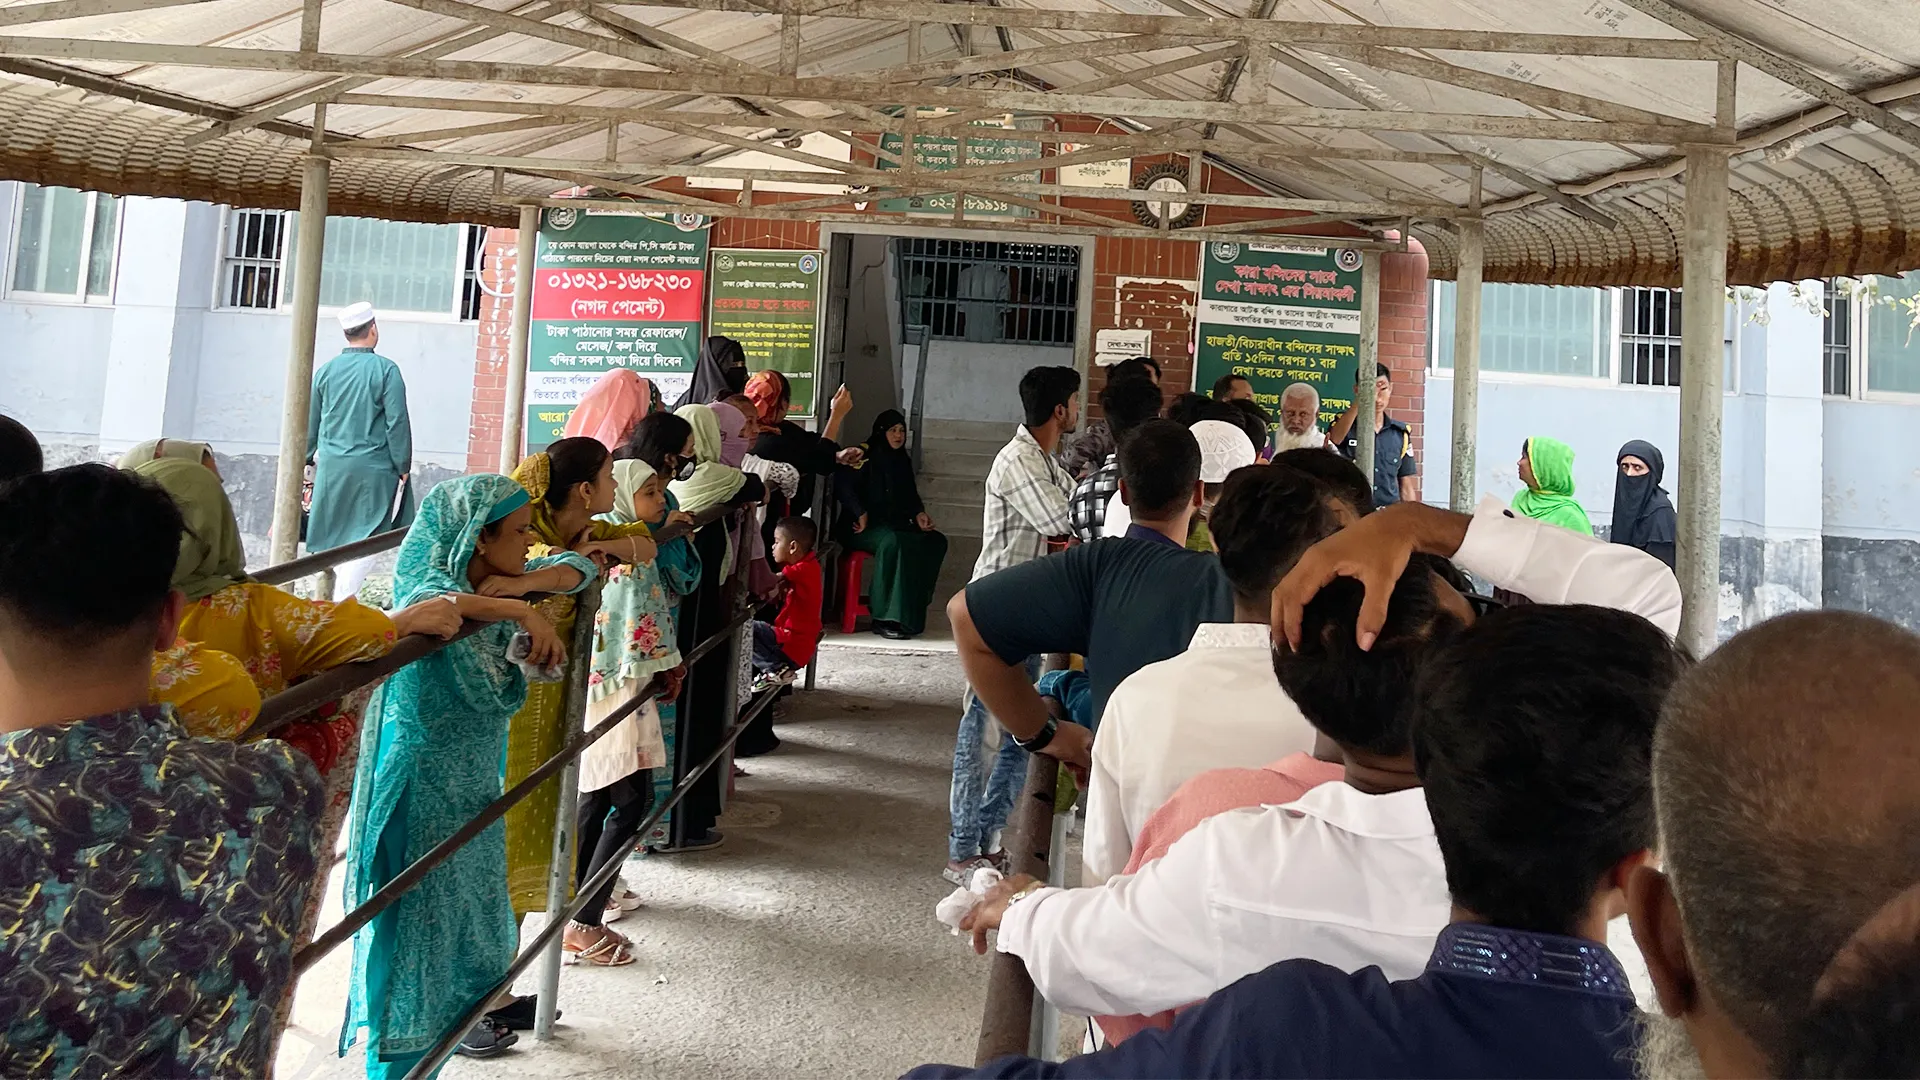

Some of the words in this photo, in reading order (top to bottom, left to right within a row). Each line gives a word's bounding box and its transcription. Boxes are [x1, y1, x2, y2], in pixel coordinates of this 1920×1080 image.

[559, 241, 576, 251] কোন
[679, 241, 695, 251] টাকা
[541, 253, 566, 263] পাঠাতে
[567, 255, 593, 263] পারবেন
[634, 256, 649, 264] নগদ
[1233, 264, 1261, 279] কারা
[1262, 264, 1308, 282] বন্দিদের
[548, 271, 692, 292] ০১৩২১-১৬৮২৩০
[1215, 279, 1243, 294] দেখা
[1243, 281, 1279, 297] সাক্ষাৎ
[1281, 285, 1301, 299] এর
[571, 298, 608, 318] (নগদ
[612, 297, 665, 319] পেমেন্ট)
[1209, 303, 1238, 313] কারাগারে
[1239, 305, 1258, 314] আটক
[1261, 306, 1274, 316] বন্দি
[1284, 309, 1305, 318] তাদের
[1233, 315, 1262, 325] অবগতির
[1263, 318, 1277, 327] জন্য
[1279, 319, 1304, 328] জানানো
[546, 324, 569, 337] টাকা
[572, 325, 613, 338] পাঠানোর
[615, 327, 638, 338] সময়
[576, 340, 613, 353] মেসেজ/
[616, 342, 633, 352] কল
[635, 339, 658, 352] দিয়ে
[1205, 334, 1282, 350] হাজতী/বিচারাধীন
[1285, 339, 1324, 354] বন্দিদের
[1325, 344, 1356, 357] সাক্ষাৎ
[549, 352, 577, 366] বন্দির
[579, 355, 603, 367] সকল
[605, 355, 626, 367] তথ্য
[629, 354, 651, 367] দিয়ে
[653, 354, 683, 367] দিবেন
[1221, 349, 1242, 362] প্রতি
[1245, 351, 1274, 364] ১৫দিন
[1277, 355, 1308, 368] পরপর
[1309, 358, 1316, 369] ১
[1319, 357, 1337, 369] বার
[570, 374, 591, 385] বন্দির
[1231, 366, 1254, 376] দেখা
[1256, 367, 1284, 379] করতে
[534, 388, 559, 400] ভিতরে
[562, 388, 578, 400] যেই
[1321, 397, 1351, 409] সাক্ষাৎ
[538, 411, 565, 423] আরো
[1319, 413, 1336, 423] বার
